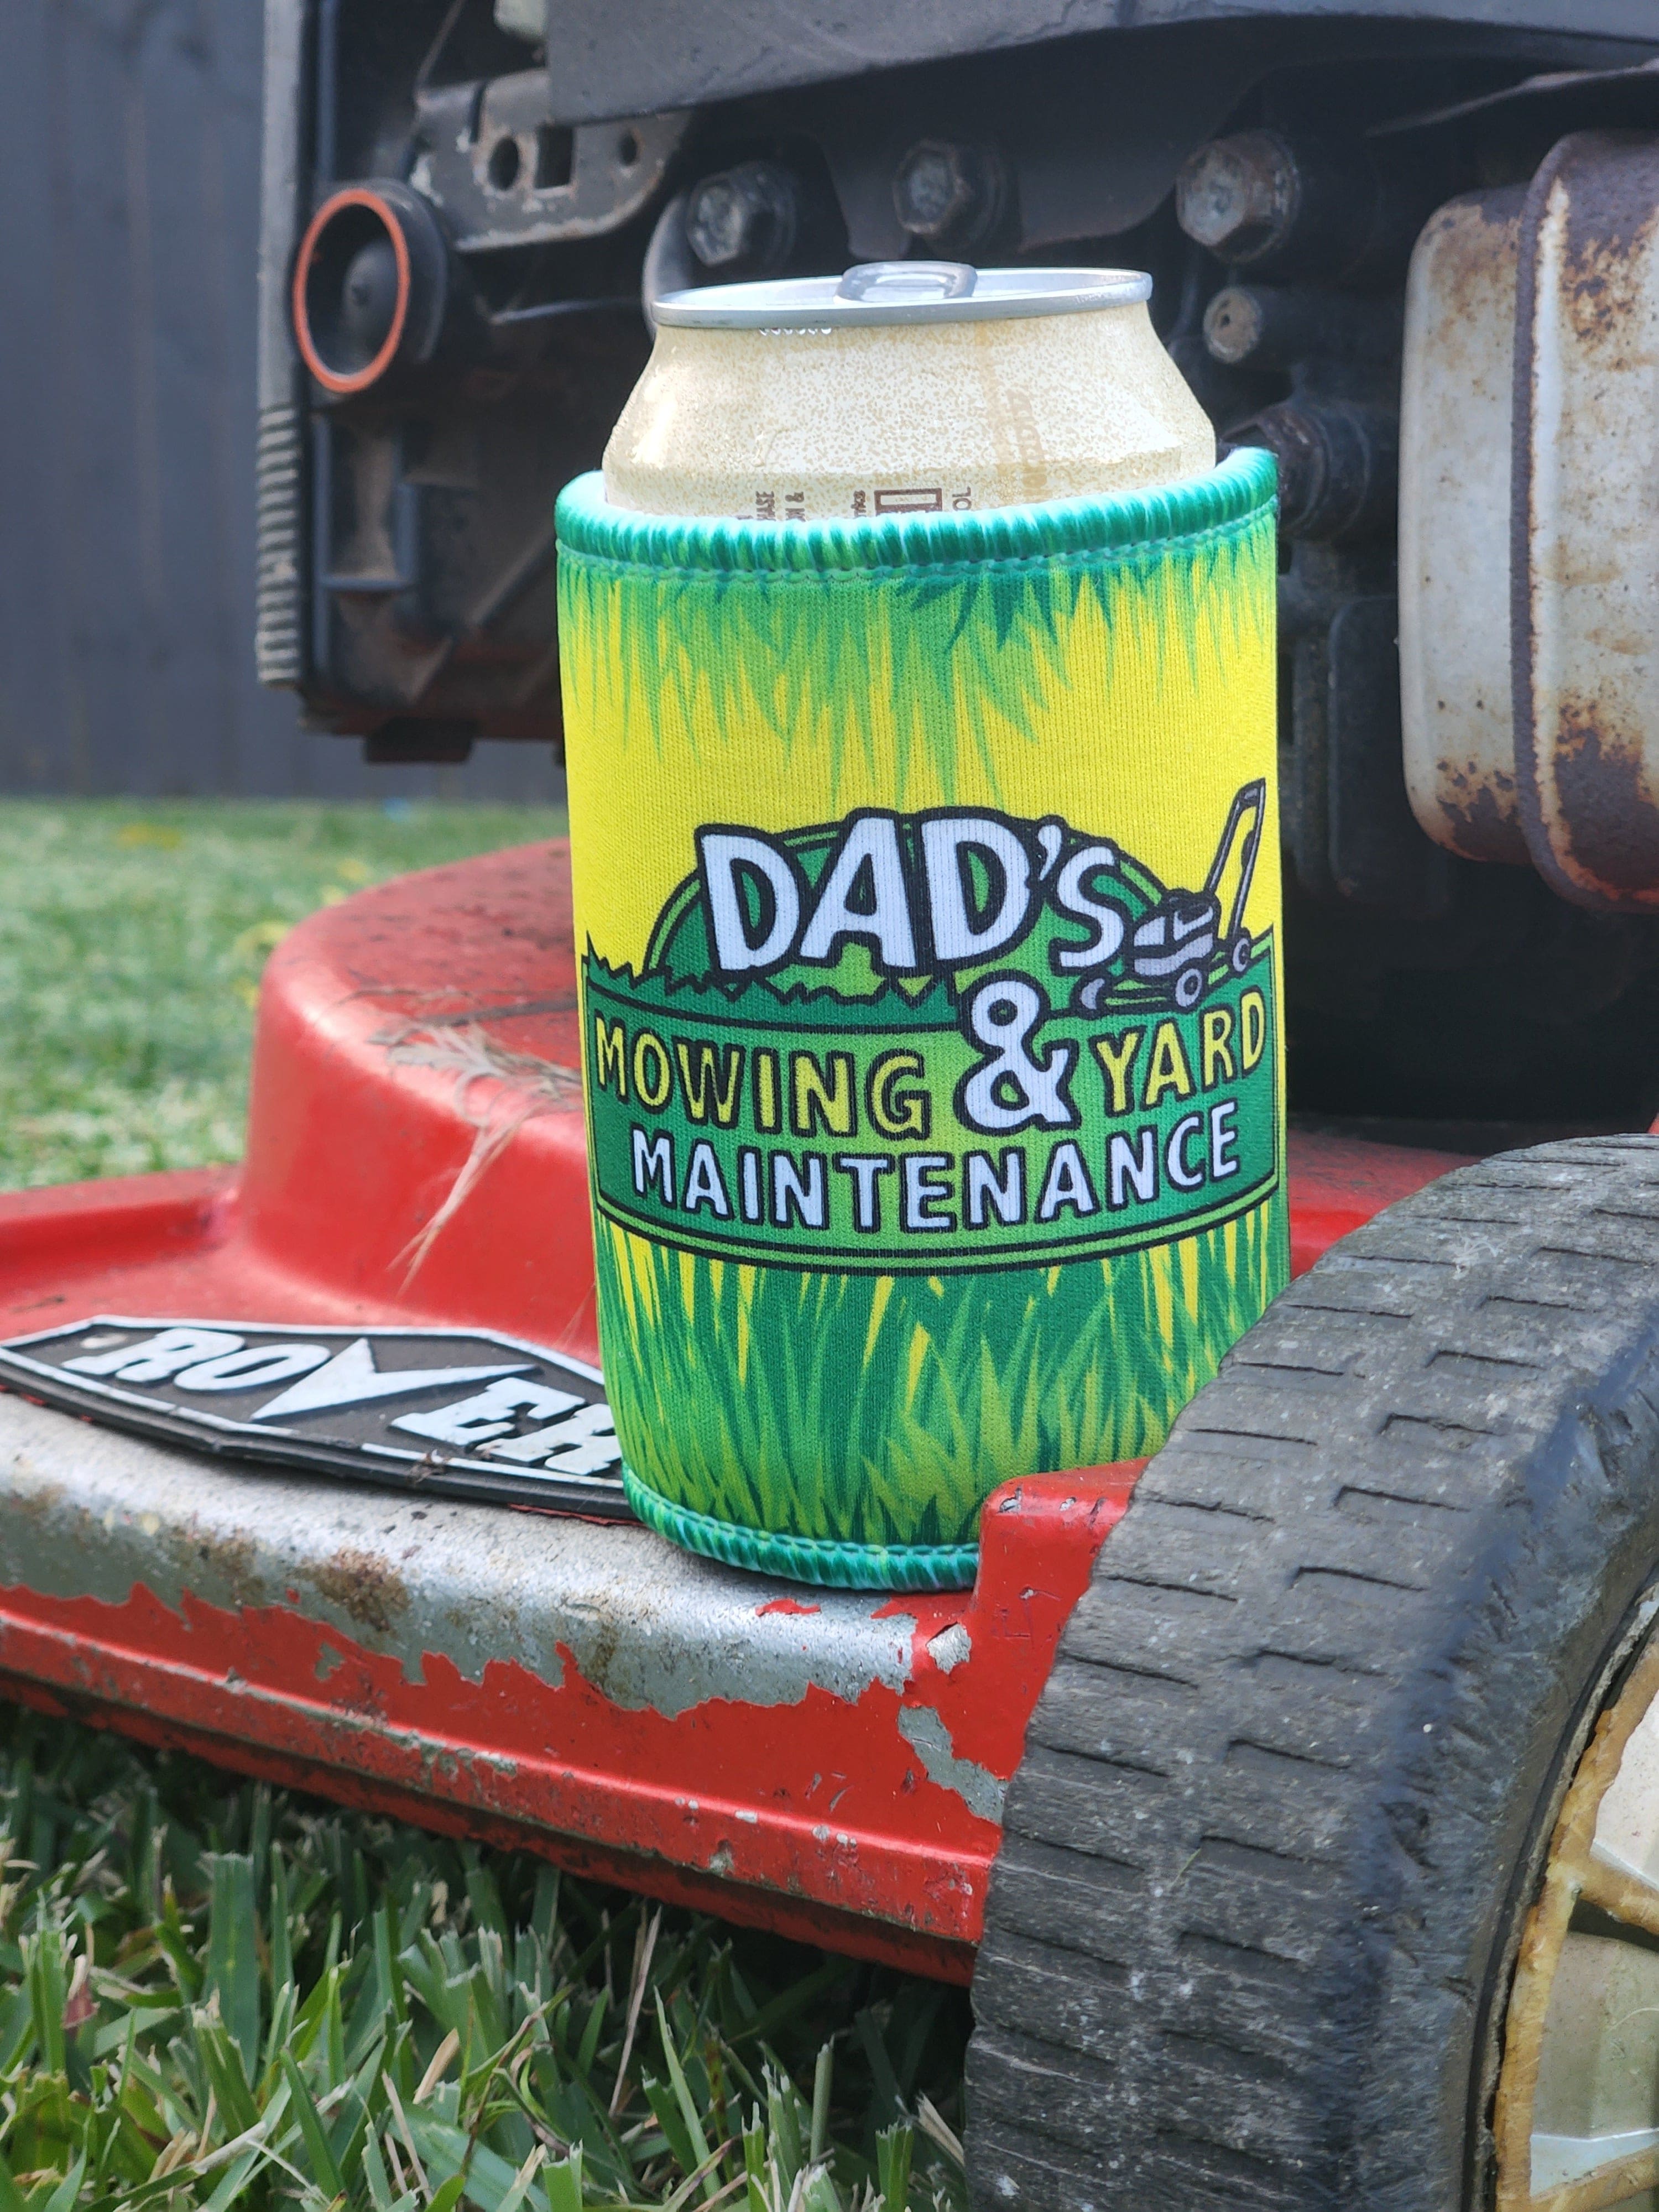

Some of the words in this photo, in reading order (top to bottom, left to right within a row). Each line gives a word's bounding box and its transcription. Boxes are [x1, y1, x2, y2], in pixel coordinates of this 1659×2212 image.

[698, 813, 1127, 973] DAD'S
[595, 1014, 926, 1134] MOWING
[961, 978, 1074, 1131] &
[1095, 990, 1267, 1114] YARD
[629, 1100, 1239, 1230] MAINTENANCE
